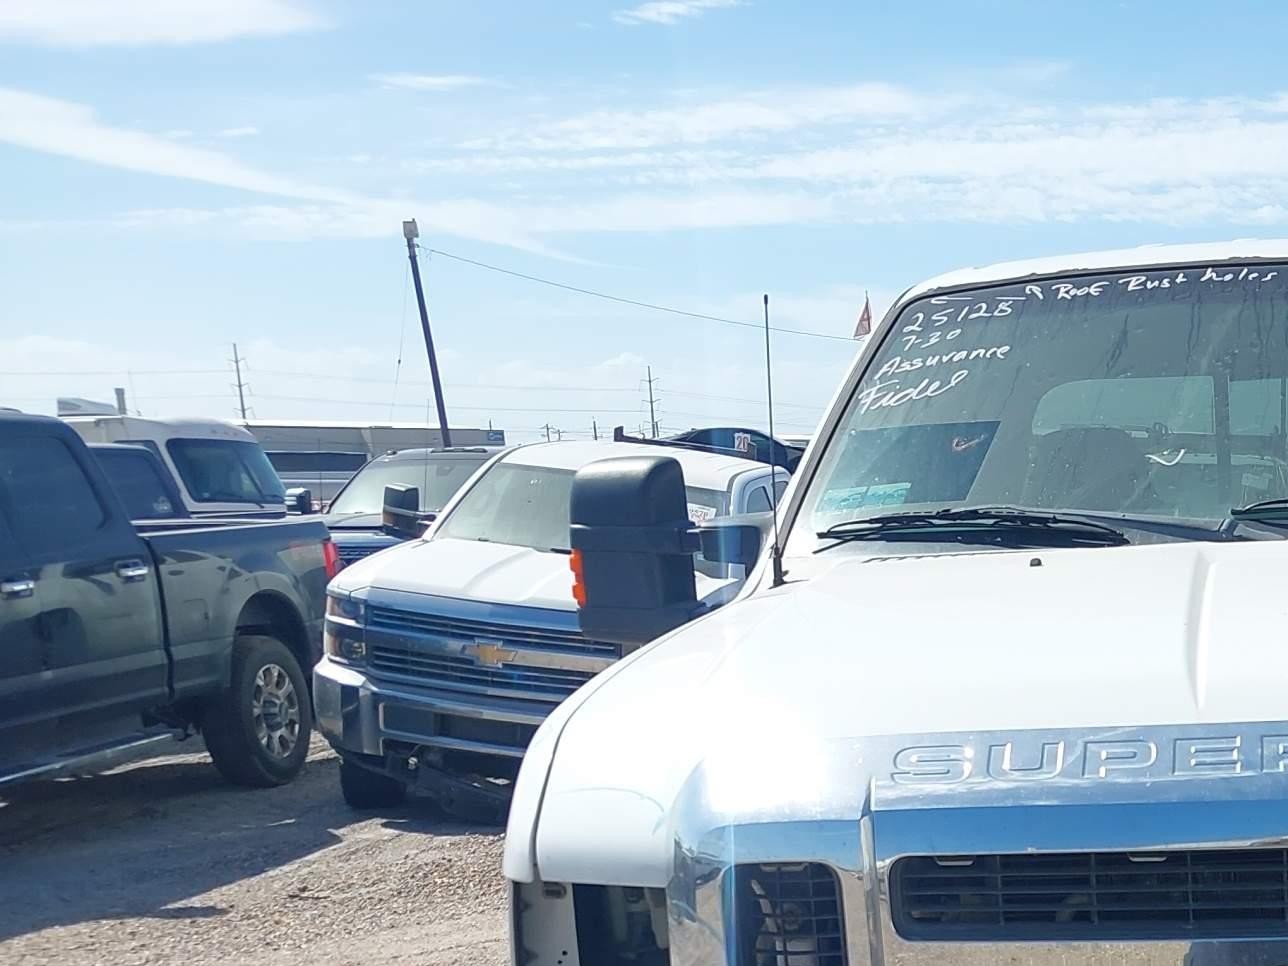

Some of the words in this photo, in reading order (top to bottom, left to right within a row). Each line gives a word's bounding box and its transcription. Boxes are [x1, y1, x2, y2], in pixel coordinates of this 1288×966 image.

[1118, 272, 1188, 292] Rust
[1200, 267, 1278, 283] holes
[902, 301, 1014, 333] 25128
[902, 329, 962, 351] 7-30
[874, 345, 1011, 380] Assurance
